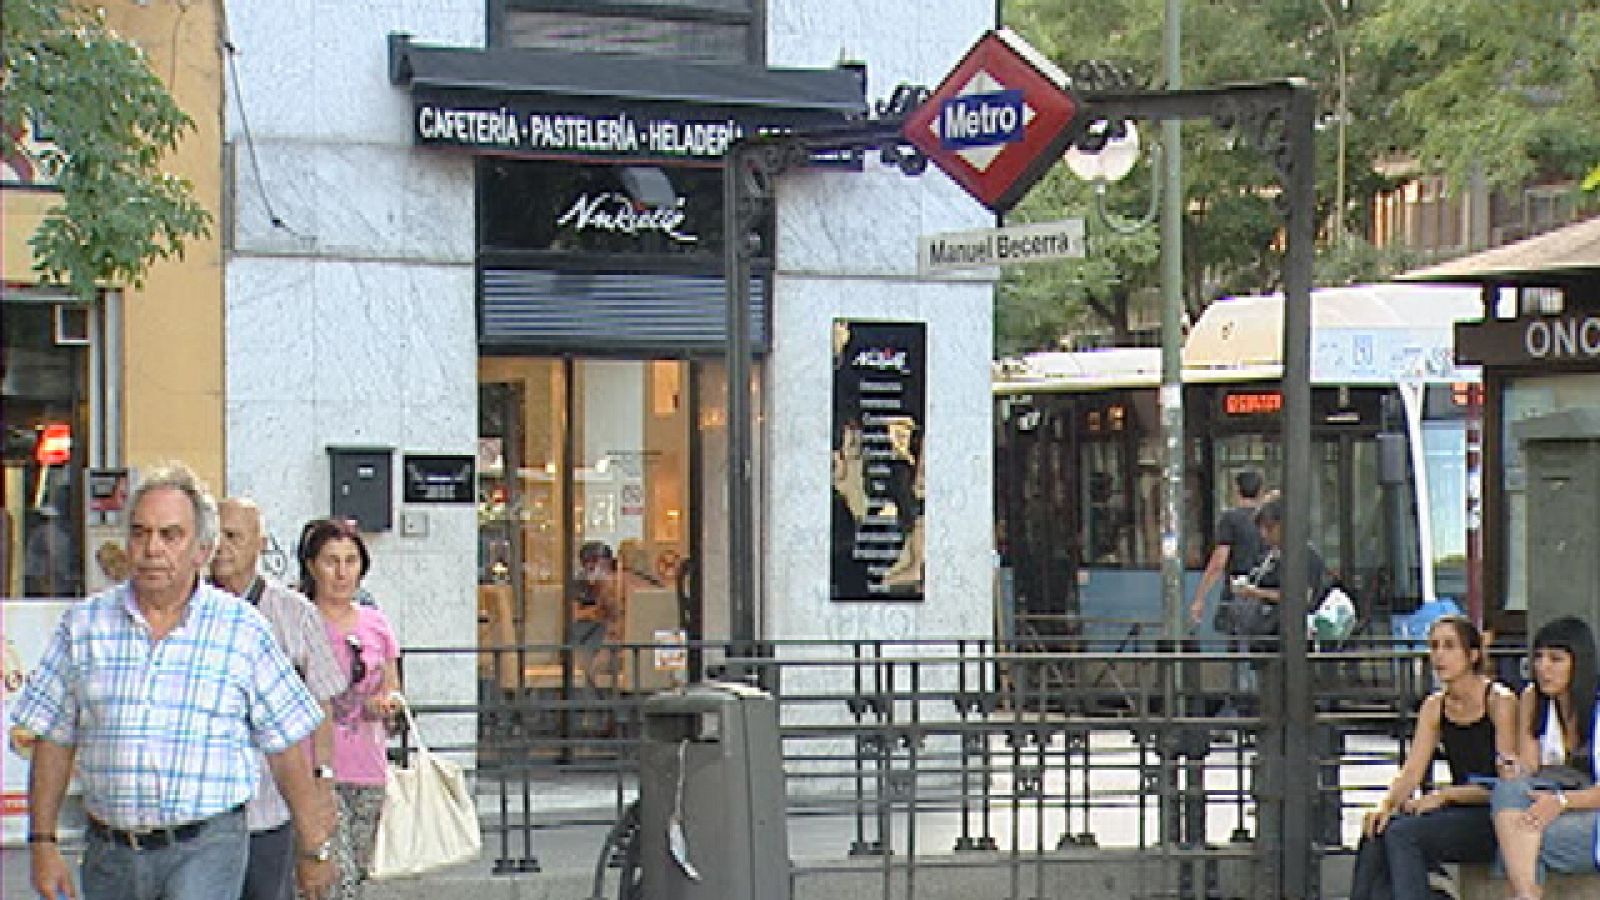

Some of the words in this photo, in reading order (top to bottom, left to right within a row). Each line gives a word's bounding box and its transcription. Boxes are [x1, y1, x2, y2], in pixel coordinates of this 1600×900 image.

[420, 106, 520, 146] CAFETERÍA
[530, 112, 638, 151] PASTELERÍA
[944, 102, 1016, 138] Metro
[929, 234, 993, 265] Manuel
[997, 232, 1069, 258] Becerra
